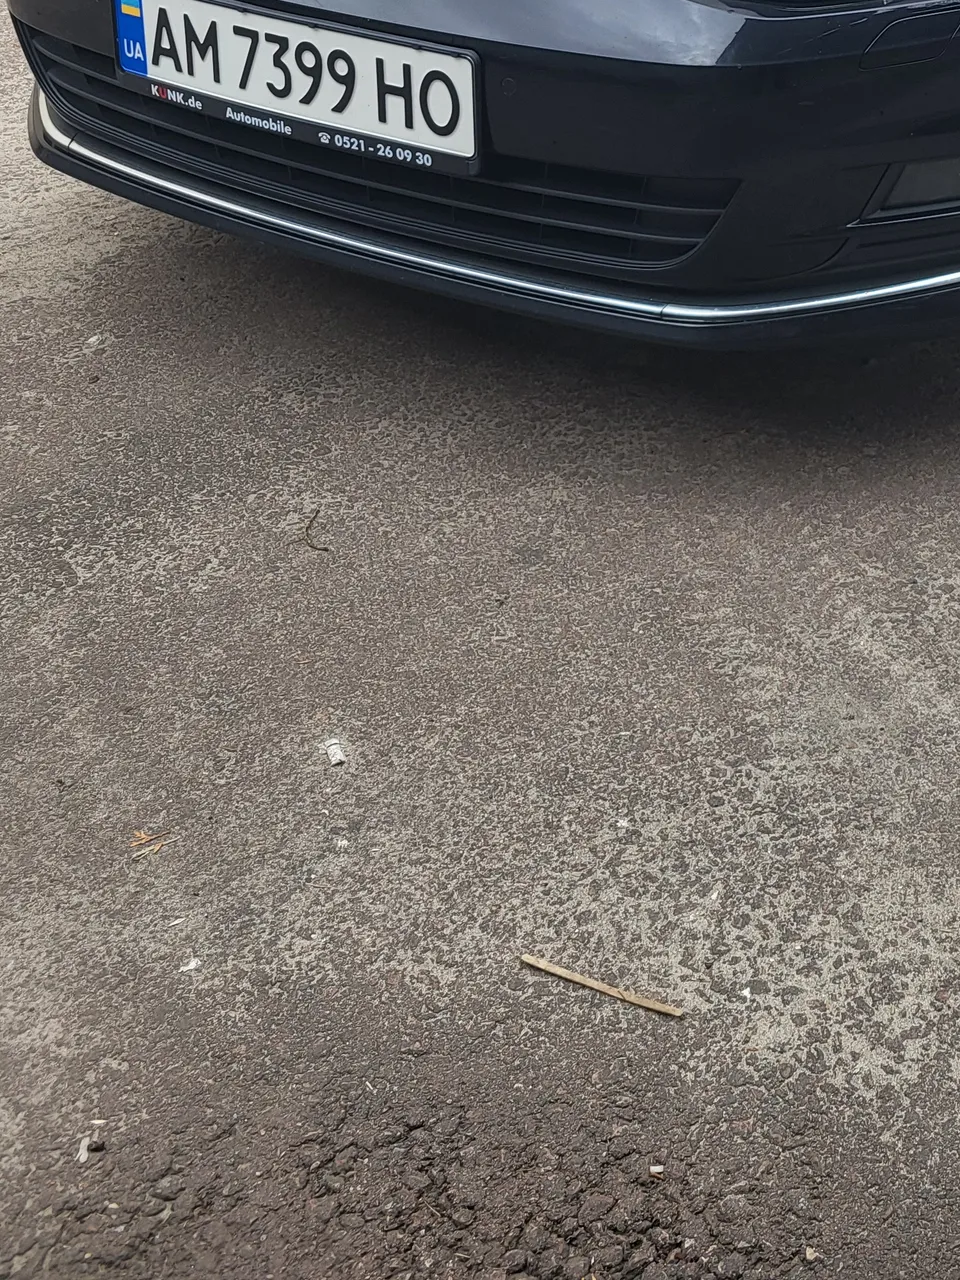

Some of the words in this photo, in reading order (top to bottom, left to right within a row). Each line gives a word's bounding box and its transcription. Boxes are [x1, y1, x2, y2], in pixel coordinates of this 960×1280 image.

[123, 37, 144, 62] UA
[151, 7, 221, 84] AM
[232, 24, 356, 114] 7399
[151, 83, 203, 111] KUNK.de
[225, 106, 292, 136] Automobile
[334, 134, 366, 153] 0521
[376, 142, 393, 158] 26
[396, 146, 413, 162] 09
[415, 151, 432, 167] 30
